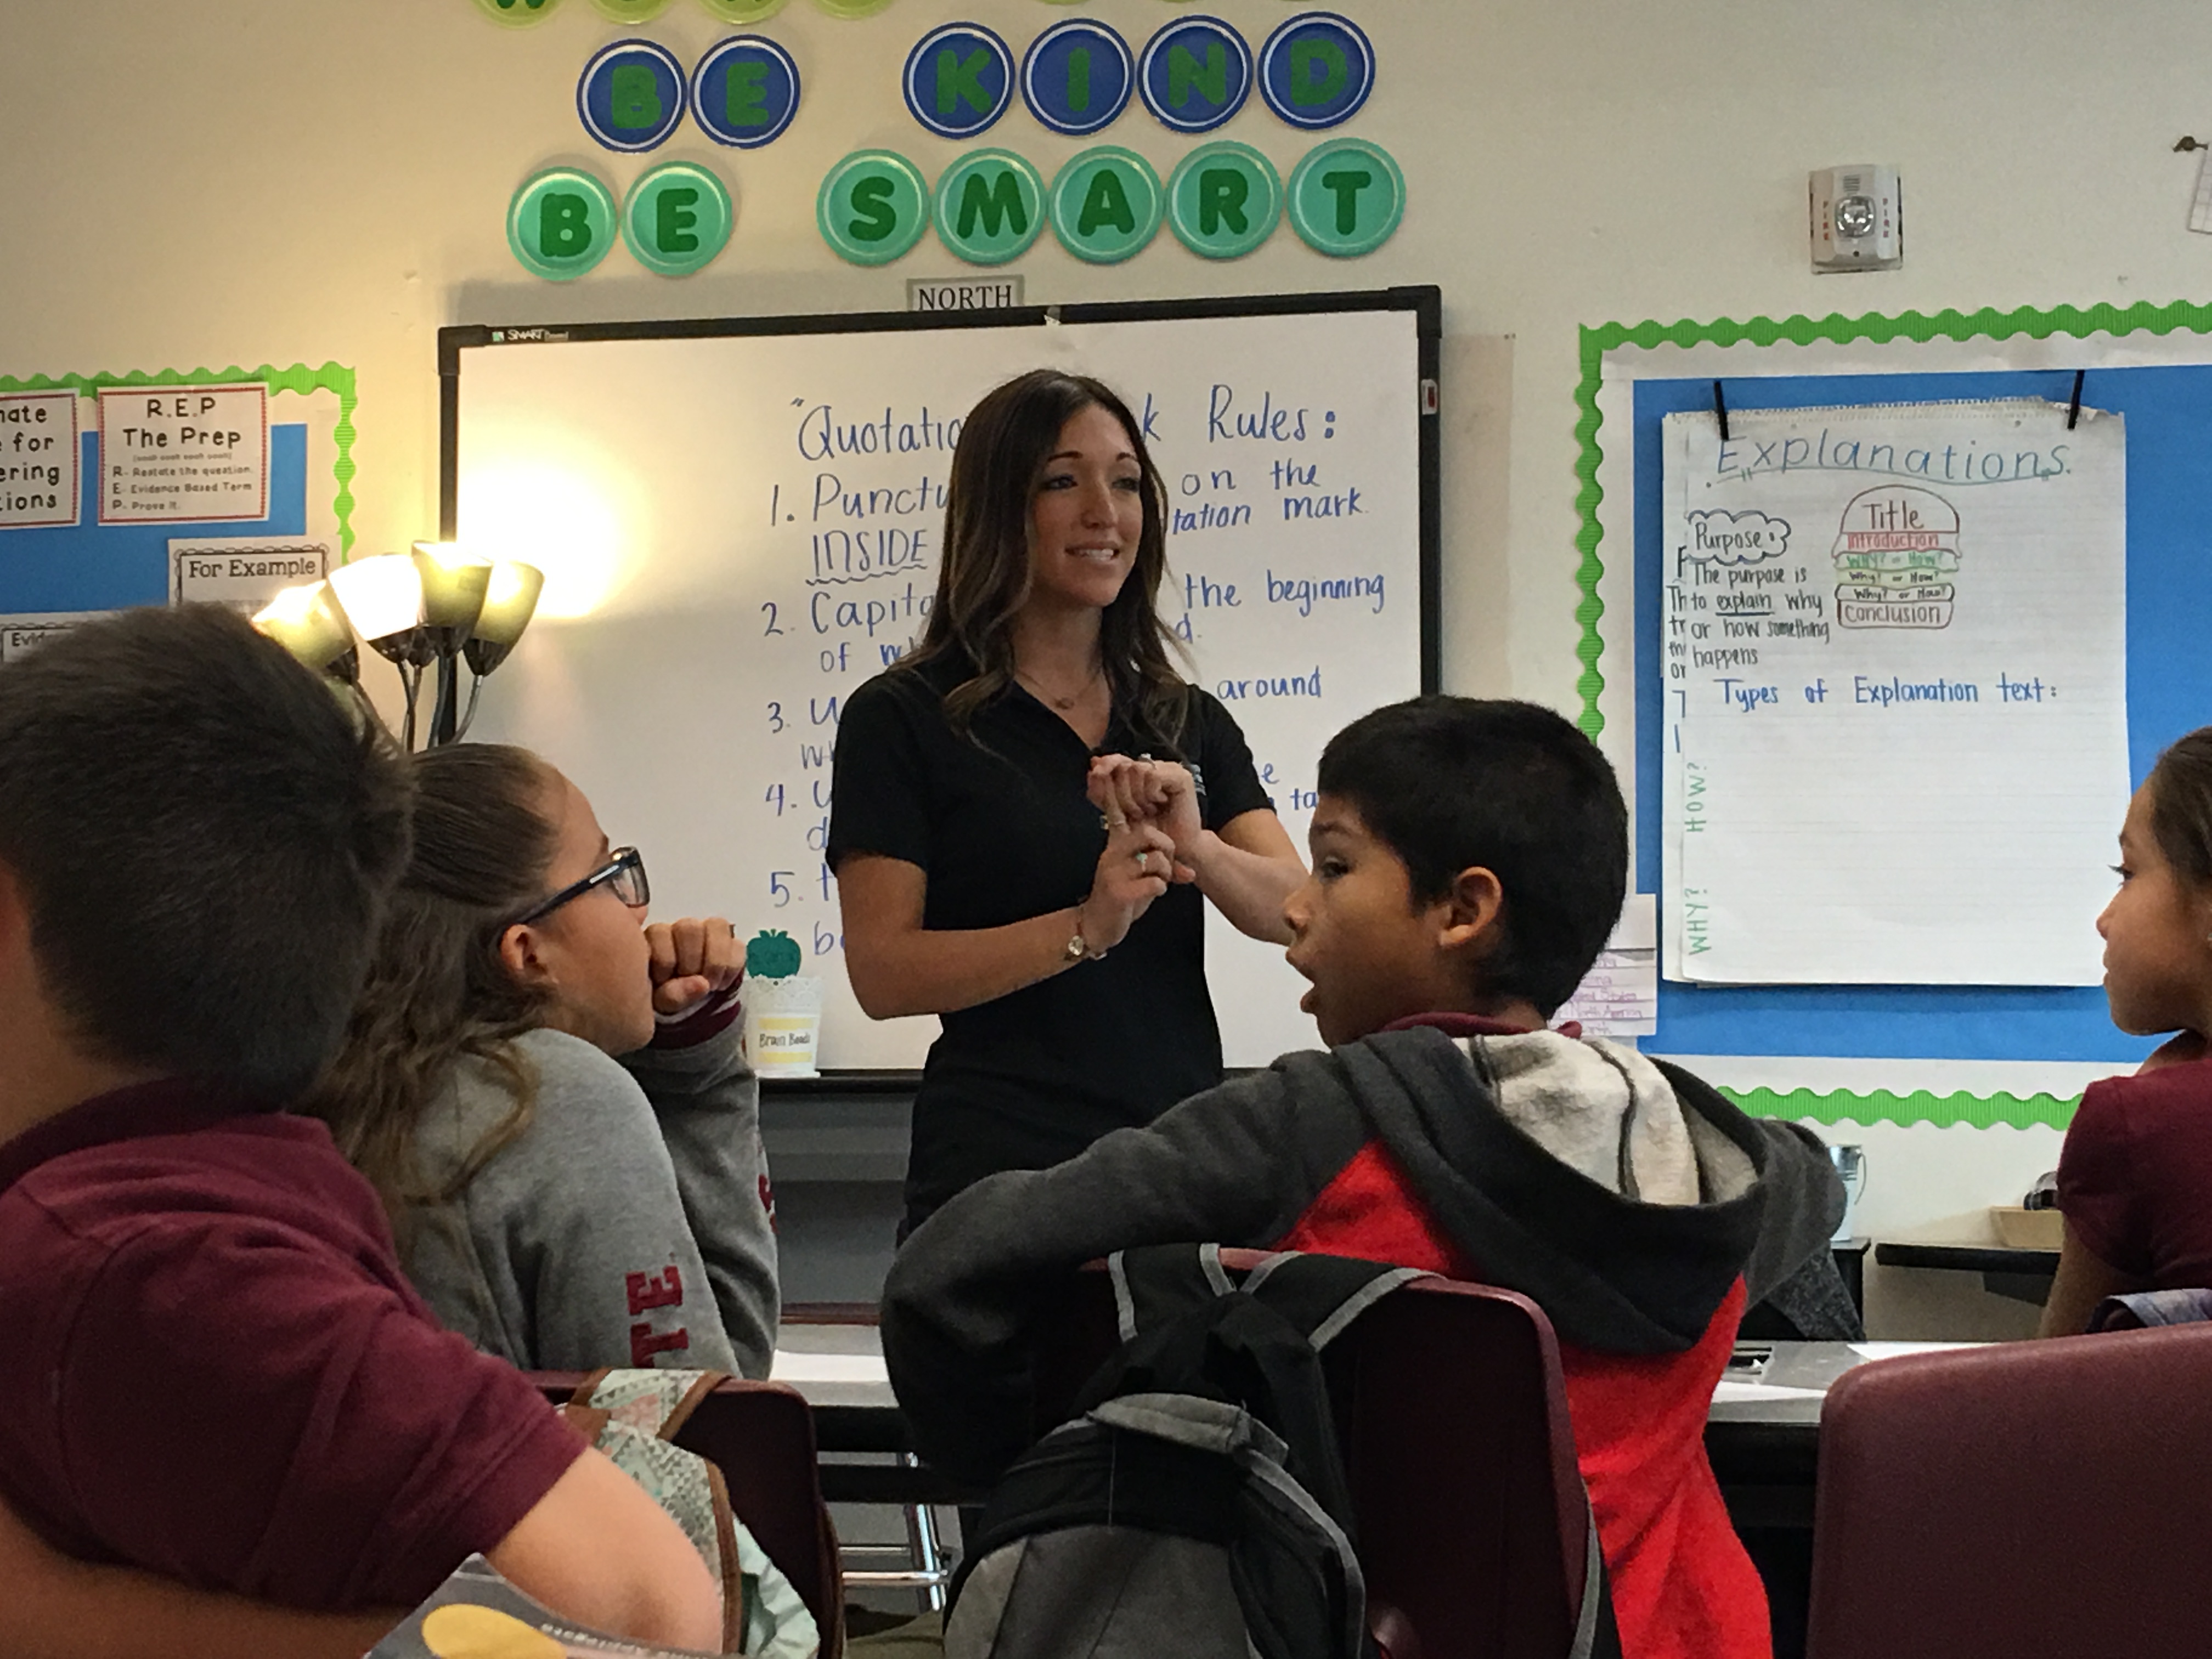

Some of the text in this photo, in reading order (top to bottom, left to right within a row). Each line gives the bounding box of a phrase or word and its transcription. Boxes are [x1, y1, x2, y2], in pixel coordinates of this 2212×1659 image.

[612, 38, 1348, 129] BE KIND
[540, 168, 1372, 257] BE SMART
[918, 284, 1012, 311] NORTH
[507, 329, 544, 341] SMART
[1209, 385, 1336, 443] Rules:
[13, 431, 54, 453] for
[123, 426, 241, 449] The Prep
[132, 467, 176, 477] Restate
[179, 467, 198, 476] the
[131, 484, 180, 494] Evidence
[184, 483, 218, 492] Based
[222, 482, 252, 492] Term
[771, 458, 1321, 527] 1. Punctu on the
[131, 501, 166, 511] Prove
[1172, 503, 1251, 535] tation
[1861, 500, 1925, 531] Title
[1847, 532, 1939, 550] Introduction
[189, 557, 316, 578] For Example
[1695, 561, 1720, 586] The
[1729, 567, 1785, 590] purpose
[1795, 567, 1807, 584] is
[1185, 574, 1242, 609] the
[1267, 569, 1385, 617] beginning
[1691, 588, 1823, 618] to explain why
[1691, 618, 1830, 645] or how something
[820, 642, 851, 673] of
[1692, 644, 1759, 670] happens
[1217, 664, 1322, 700] around
[1713, 678, 1779, 713] Types
[1804, 678, 1829, 704] of
[1854, 676, 1979, 708] Explanation
[1996, 672, 2058, 703] text:
[765, 783, 797, 817] 4.
[1684, 762, 1707, 833] HOW?
[1684, 888, 1712, 956] WHY?
